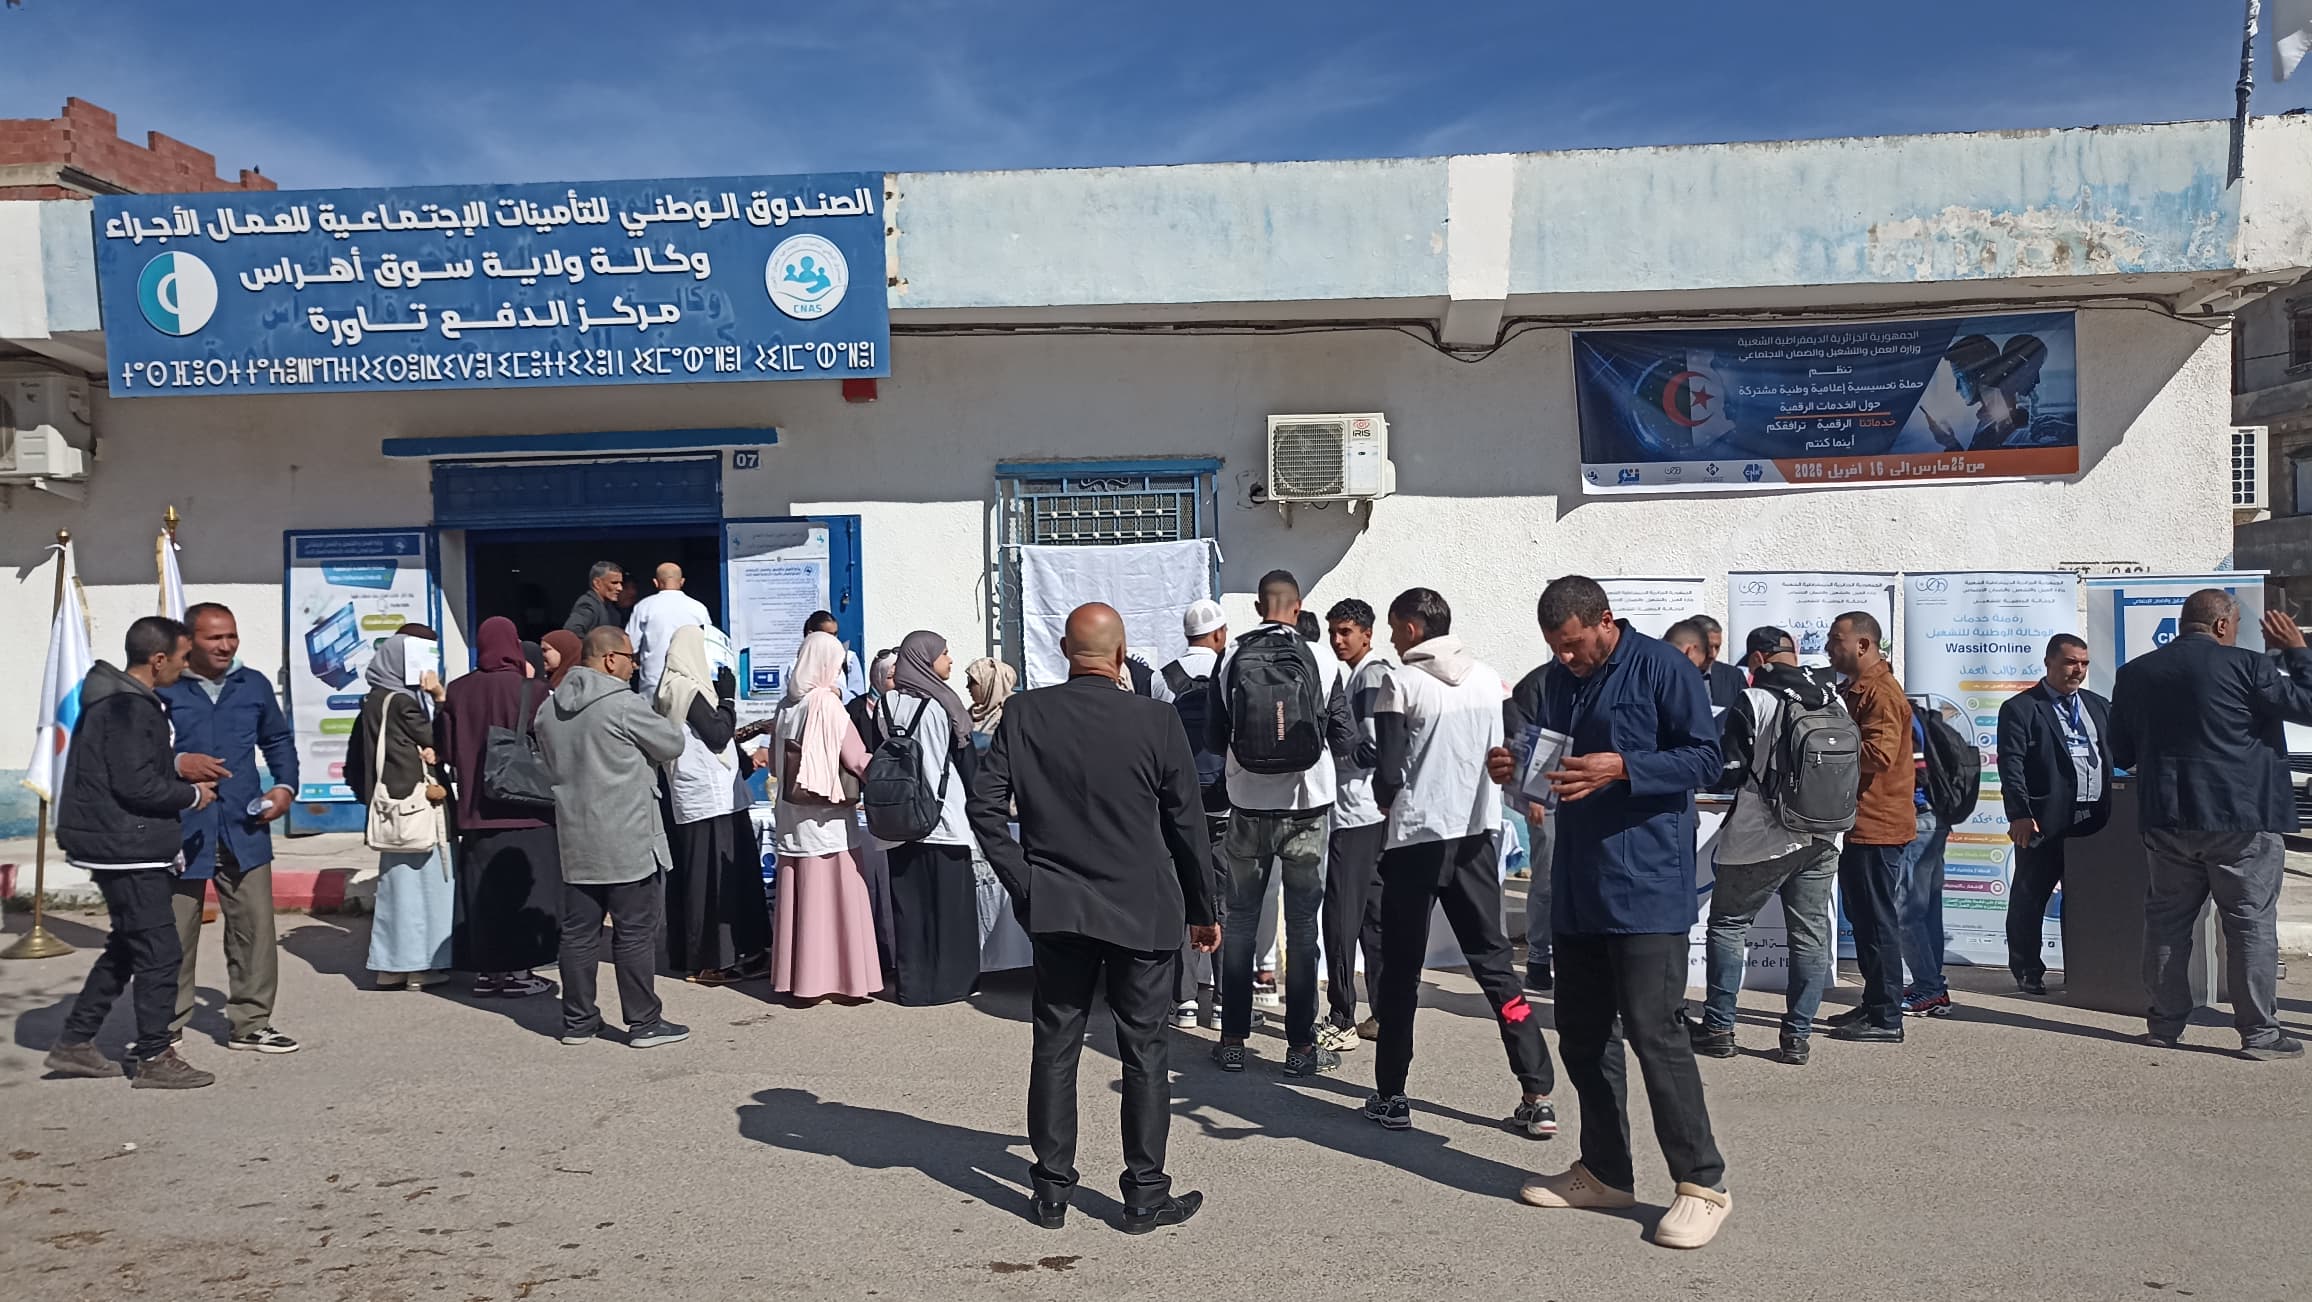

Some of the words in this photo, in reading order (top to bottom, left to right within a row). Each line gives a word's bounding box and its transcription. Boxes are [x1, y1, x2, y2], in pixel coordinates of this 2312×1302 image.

[495, 189, 610, 233] للتأمينات
[745, 187, 875, 227] الصندوق
[318, 200, 489, 239] الإجتماعية
[619, 192, 740, 237] الوطني
[105, 205, 200, 244] الأجراء
[207, 206, 310, 242] للعمال
[239, 246, 365, 291] أهراس
[482, 249, 585, 285] ولاية
[591, 243, 712, 280] وكالة
[374, 253, 474, 288] سوق
[577, 295, 681, 333] مركز
[793, 304, 823, 313] CNAS
[308, 303, 428, 346] تاورة
[440, 299, 570, 339] الدفع
[1830, 332, 1868, 347] الجزائرية
[1869, 330, 1919, 345] الجمهورية
[1870, 345, 1898, 356] العمل
[1900, 344, 1921, 355] وزارة
[1808, 365, 1852, 378] تنظم
[1738, 385, 1777, 397] مشتركة
[1779, 384, 1808, 396] وطنية
[1811, 382, 1846, 395] إعلامية
[1847, 381, 1896, 392] تحسيسية
[1899, 379, 1924, 389] حملة
[1780, 401, 1813, 414] الرقمية
[1816, 400, 1856, 411] الخدمات
[1858, 400, 1881, 412] حول
[1766, 421, 1806, 433] ترافقكم
[1817, 418, 1852, 431] الرقمية
[1352, 429, 1371, 437] IRIS
[1805, 438, 1830, 451] كنتم
[1832, 434, 1855, 449] أينما
[736, 453, 757, 467] 07
[1951, 457, 1964, 471] 25
[1794, 463, 1822, 478] 2026
[1870, 461, 1883, 476] 16
[1912, 460, 1950, 475] مارس
[1966, 462, 1985, 473] من
[1945, 642, 2032, 653] WassitOnline
[1761, 956, 1776, 967] de
